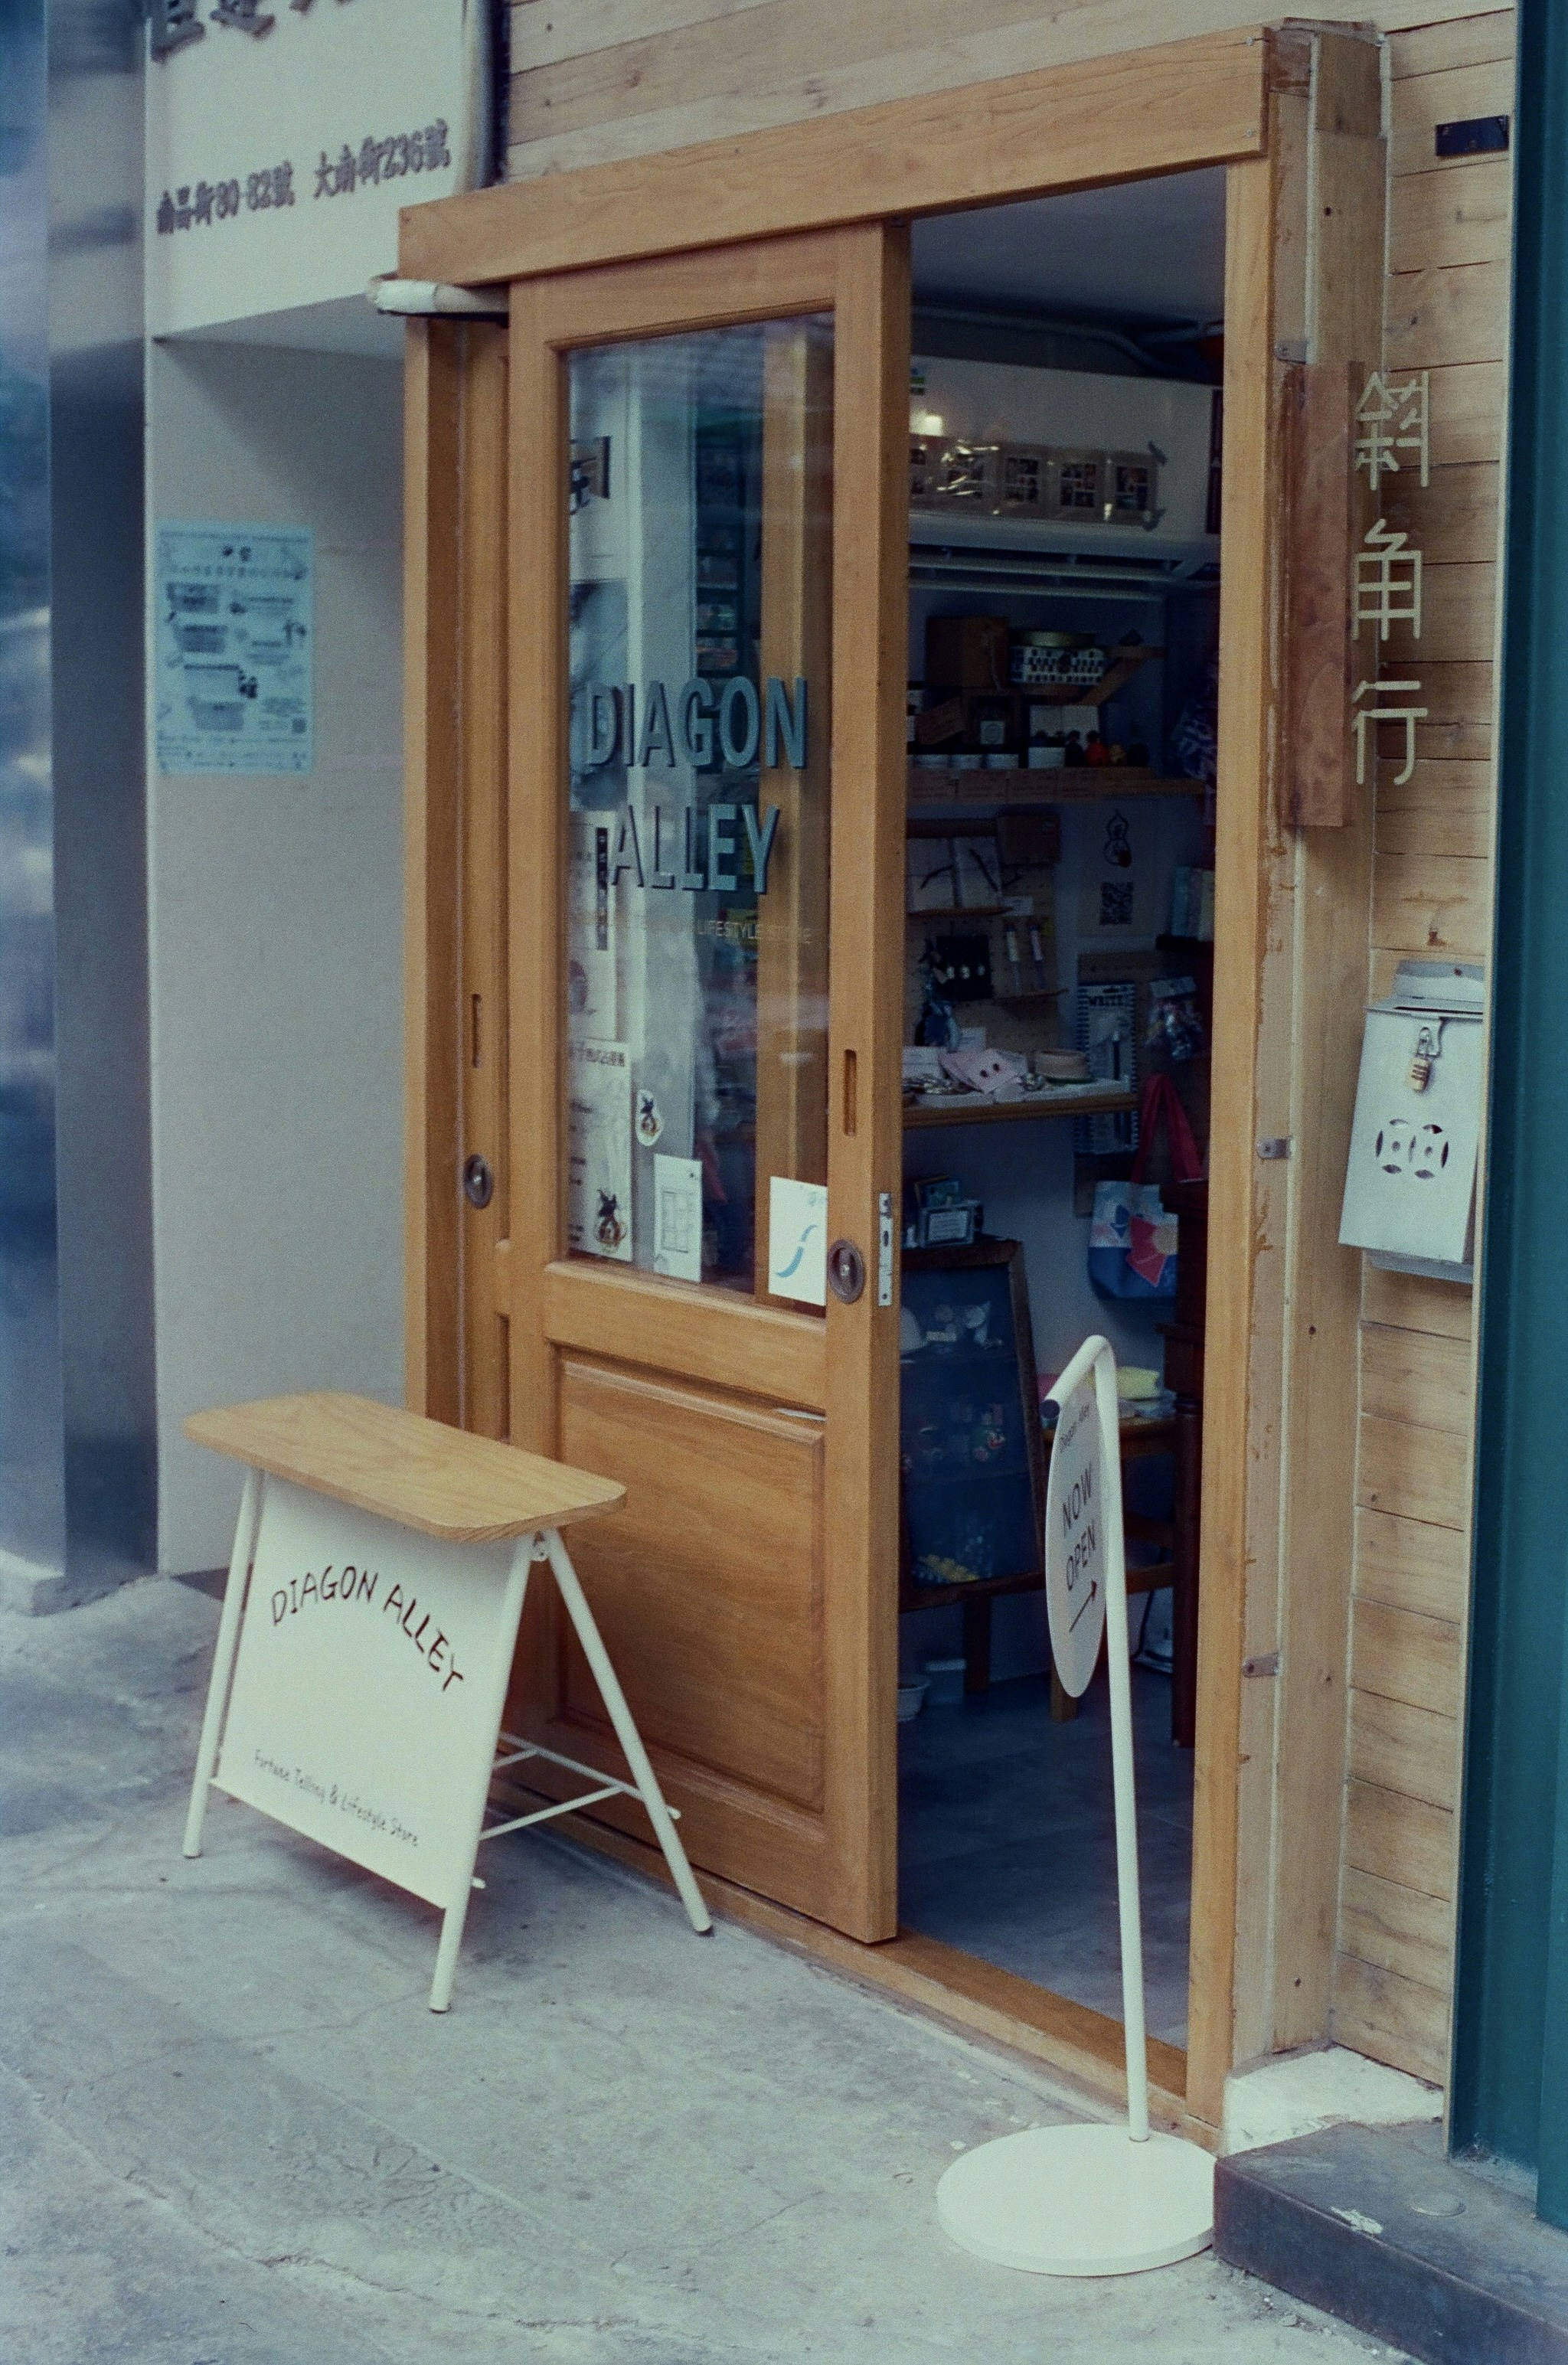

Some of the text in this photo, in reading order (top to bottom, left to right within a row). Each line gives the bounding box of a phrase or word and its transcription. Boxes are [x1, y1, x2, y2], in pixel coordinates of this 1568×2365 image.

[1351, 370, 1431, 786] 斜角行
[586, 675, 808, 769] DIAGON
[610, 802, 781, 895] ALLEY
[1062, 1461, 1092, 1537] NOW
[1066, 1519, 1096, 1591] OPEN
[270, 1565, 464, 1693] DIAGON ALLEY
[255, 1749, 290, 1782] Fortune
